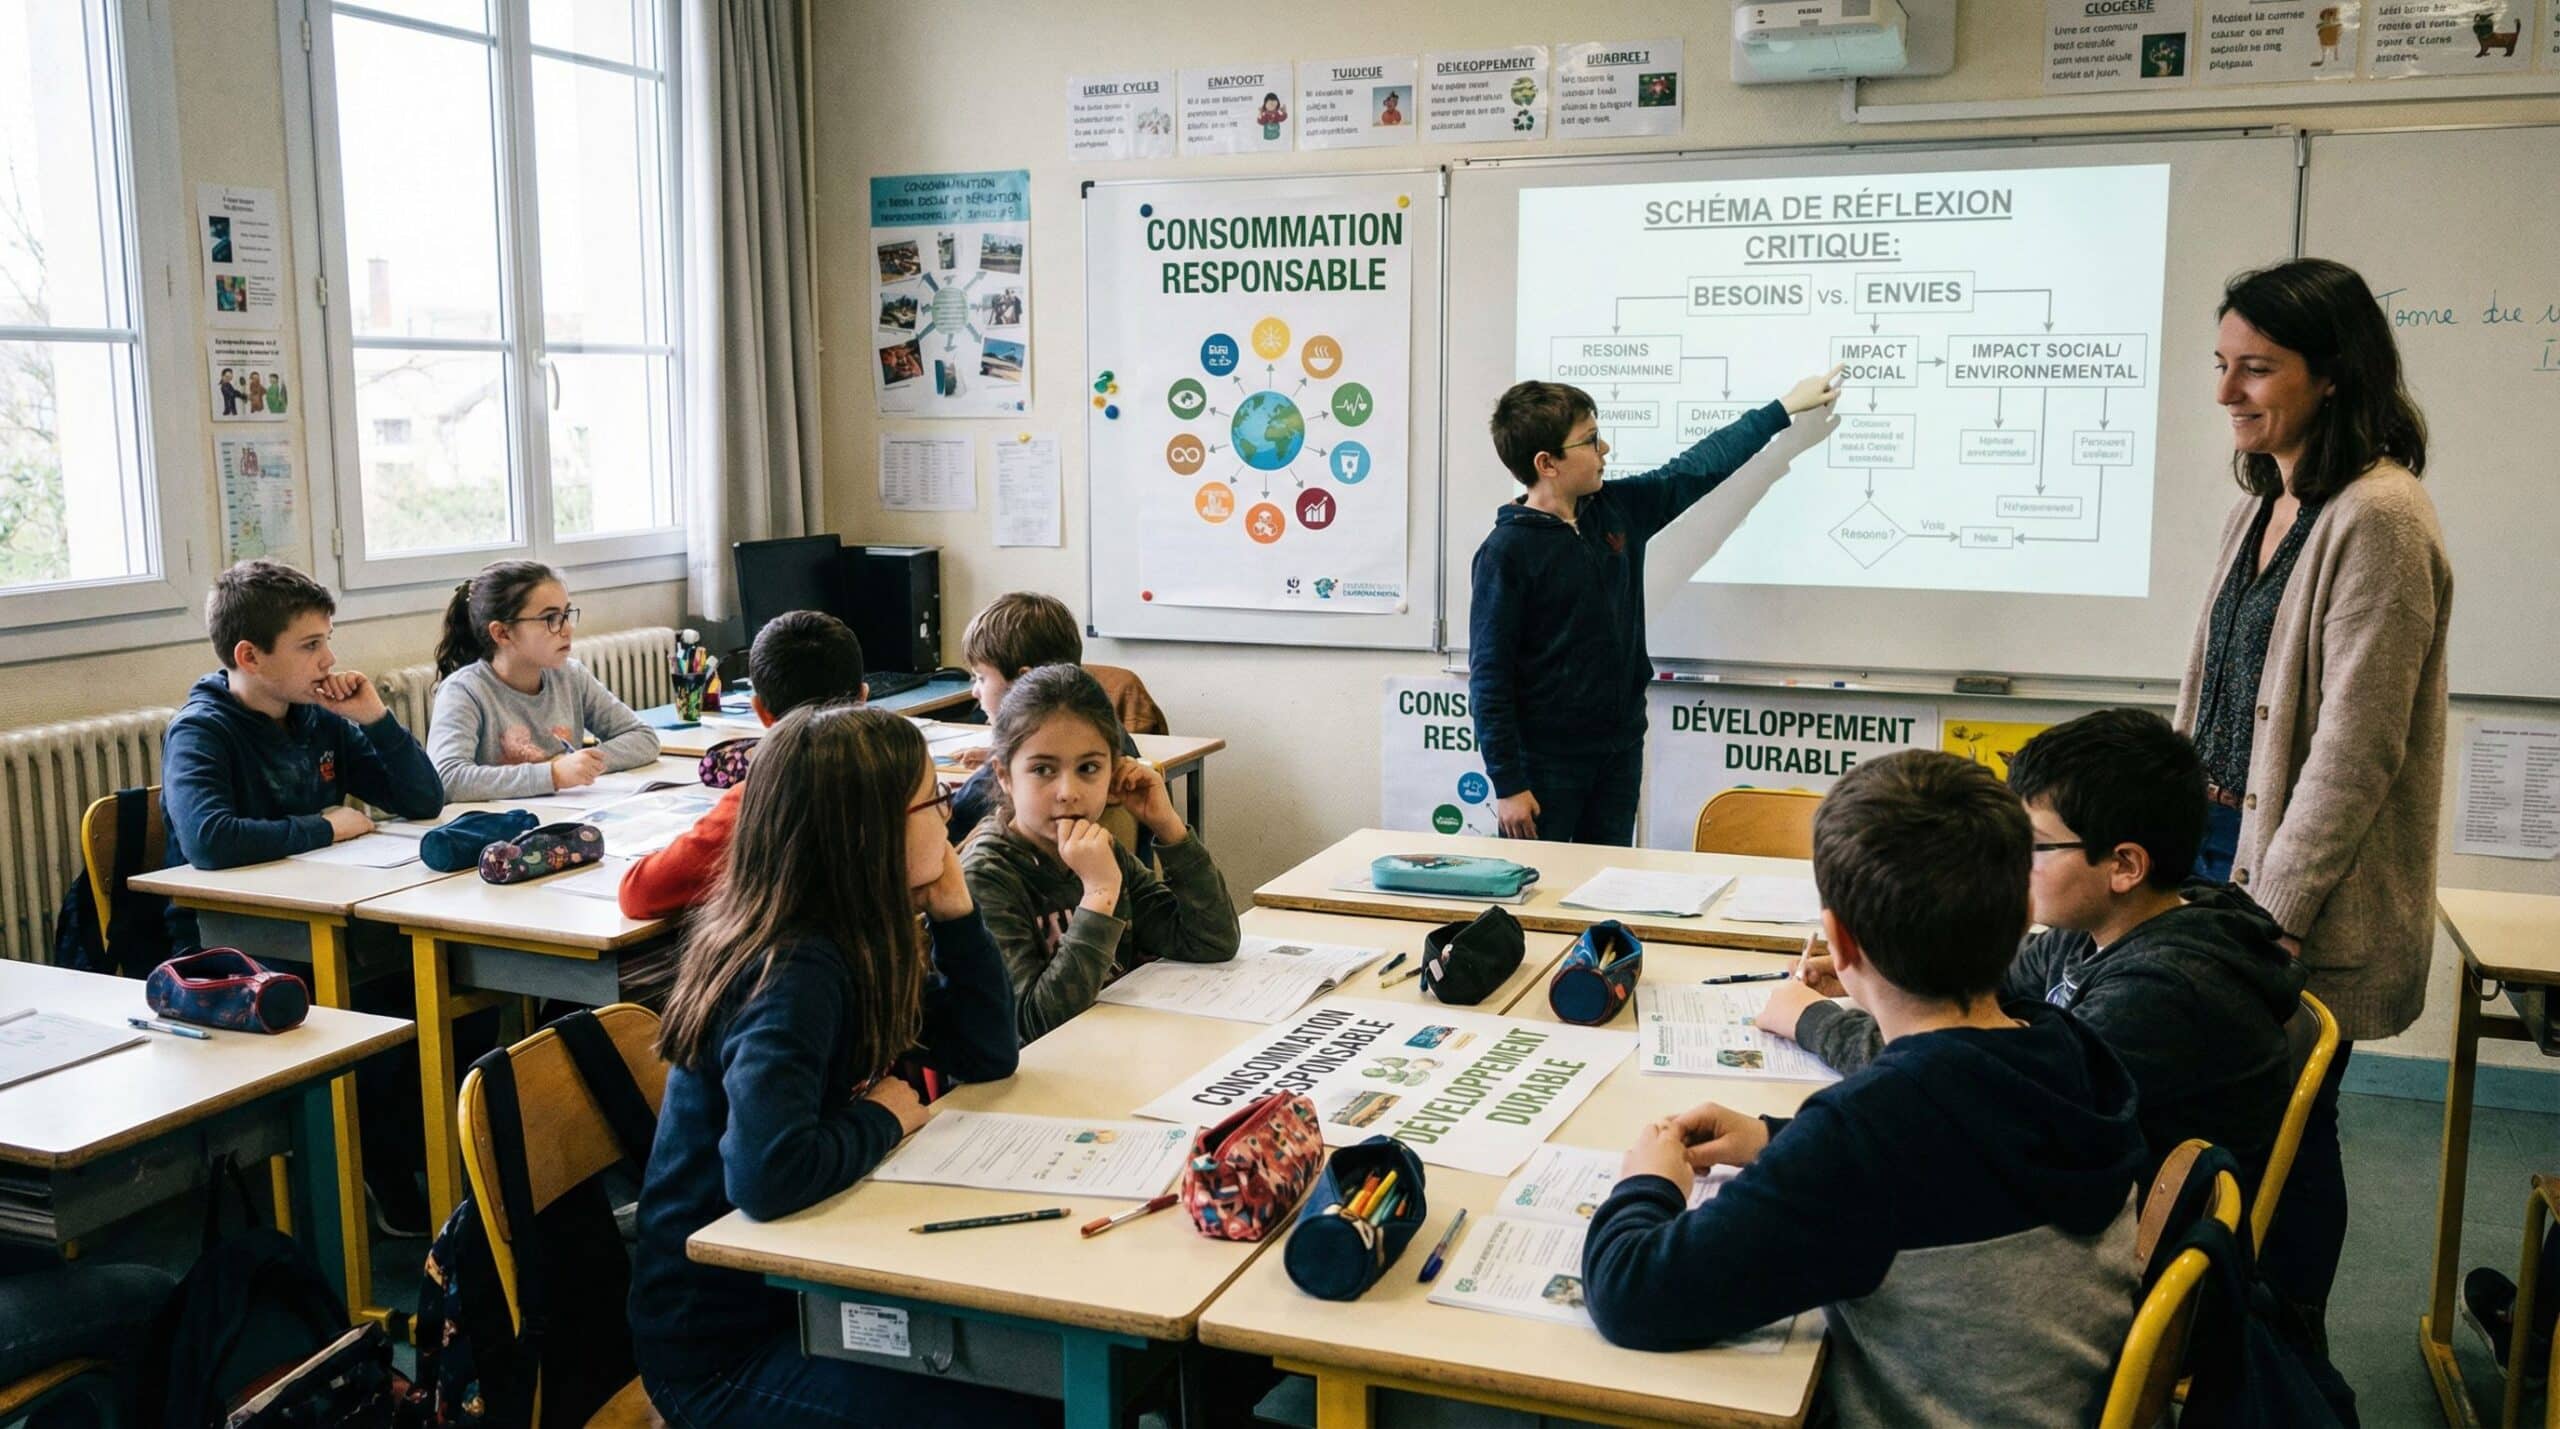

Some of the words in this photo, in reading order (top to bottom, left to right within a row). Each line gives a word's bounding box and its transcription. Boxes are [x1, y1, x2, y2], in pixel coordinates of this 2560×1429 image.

[1644, 193, 1772, 225] SCHÉMA
[1782, 196, 1822, 220] DE
[1832, 188, 2013, 219] RÉFLEXION
[1147, 212, 1403, 251] CONSOMMATION
[1746, 232, 1901, 260] CRITIQUE:
[1162, 258, 1387, 294] RESPONSABLE
[1693, 285, 1804, 306] BESOINS
[1867, 281, 1962, 304] ENVIES
[1582, 343, 1649, 357] RESOINS
[1841, 344, 1907, 359] IMPACT
[1972, 343, 2041, 358] IMPACT
[2046, 342, 2122, 359] SOCIAL/
[1840, 365, 1907, 381] SOCIAL
[1955, 363, 2139, 380] ENVIRONNEMENTAL
[1400, 690, 1473, 718] CONS
[1672, 701, 1916, 744] DÉVELOPPEMENT
[1725, 743, 1857, 776] DURABLE
[1192, 1009, 1355, 1106] CONSOMMATION
[1393, 1028, 1550, 1144] DÉVELOPPEMENT
[1485, 1058, 1587, 1126] DURABLE
